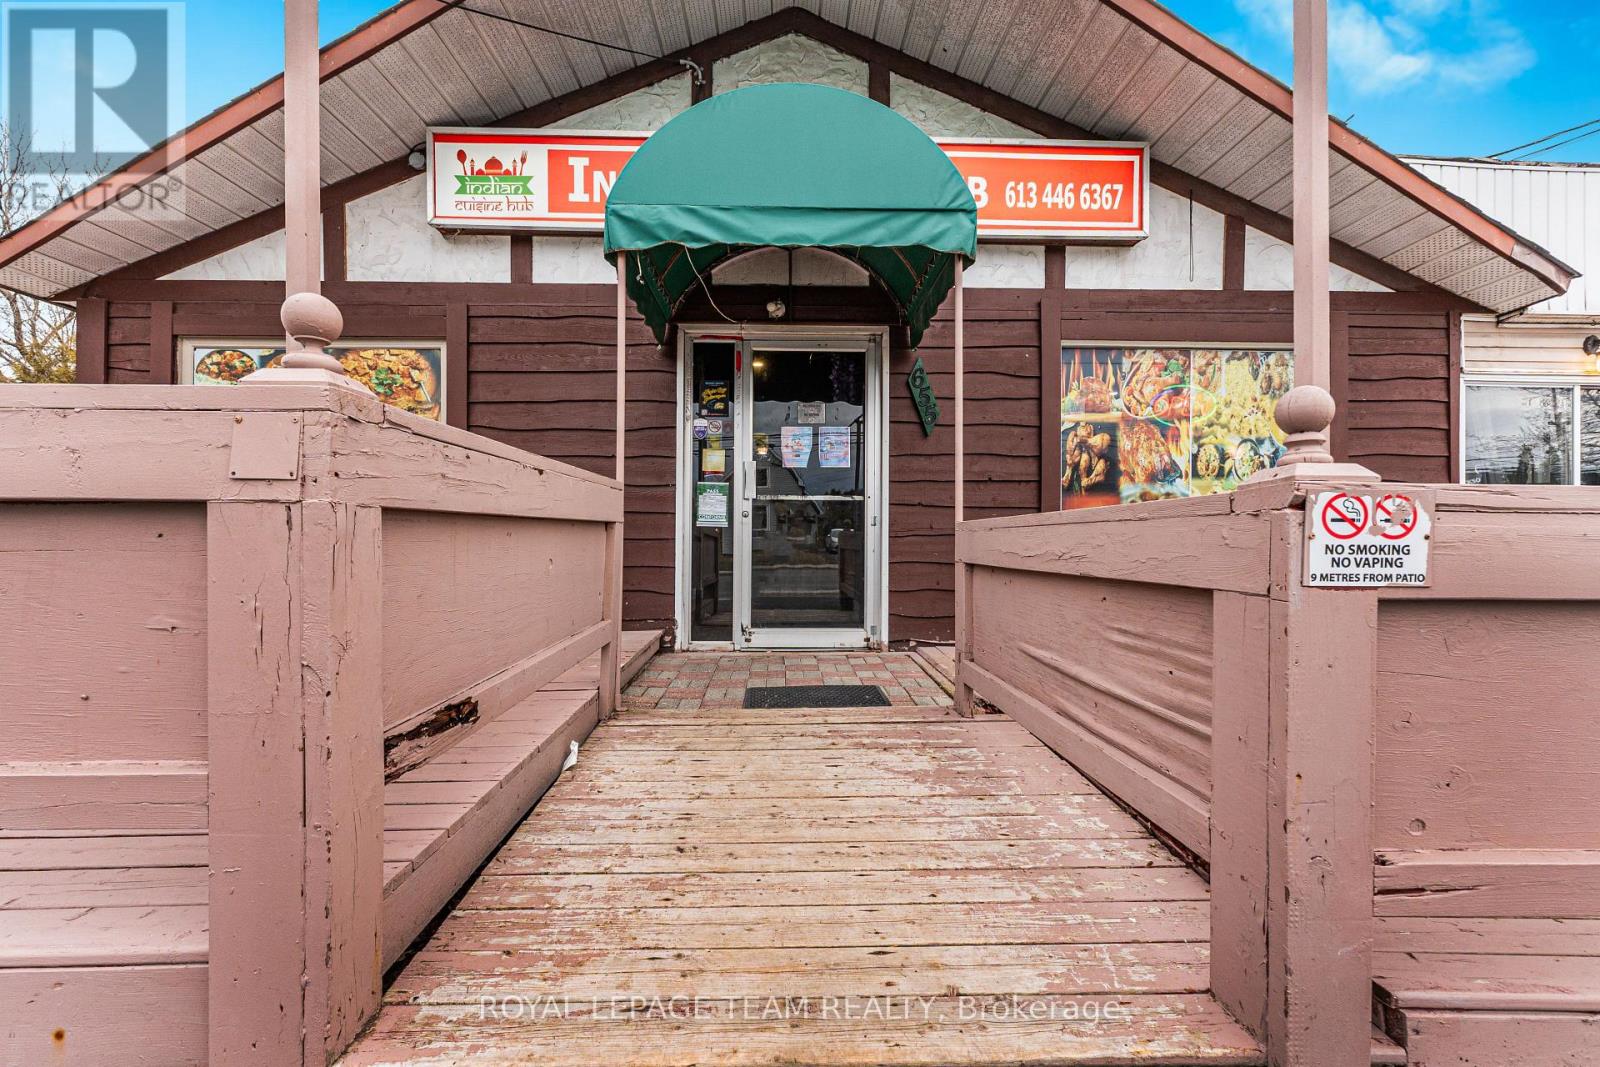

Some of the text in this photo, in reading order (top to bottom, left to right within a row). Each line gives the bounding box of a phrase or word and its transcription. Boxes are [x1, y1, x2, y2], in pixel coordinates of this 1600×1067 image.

[465, 175, 524, 194] indian
[1005, 181, 1037, 208] 613
[1042, 182, 1075, 209] 446
[1080, 183, 1123, 210] 6367
[505, 195, 534, 212] hub
[1325, 544, 1410, 556] NO SMOKING
[1331, 557, 1404, 568] NO VAPING
[1310, 573, 1426, 583] 9 METRES FROM PATIO
